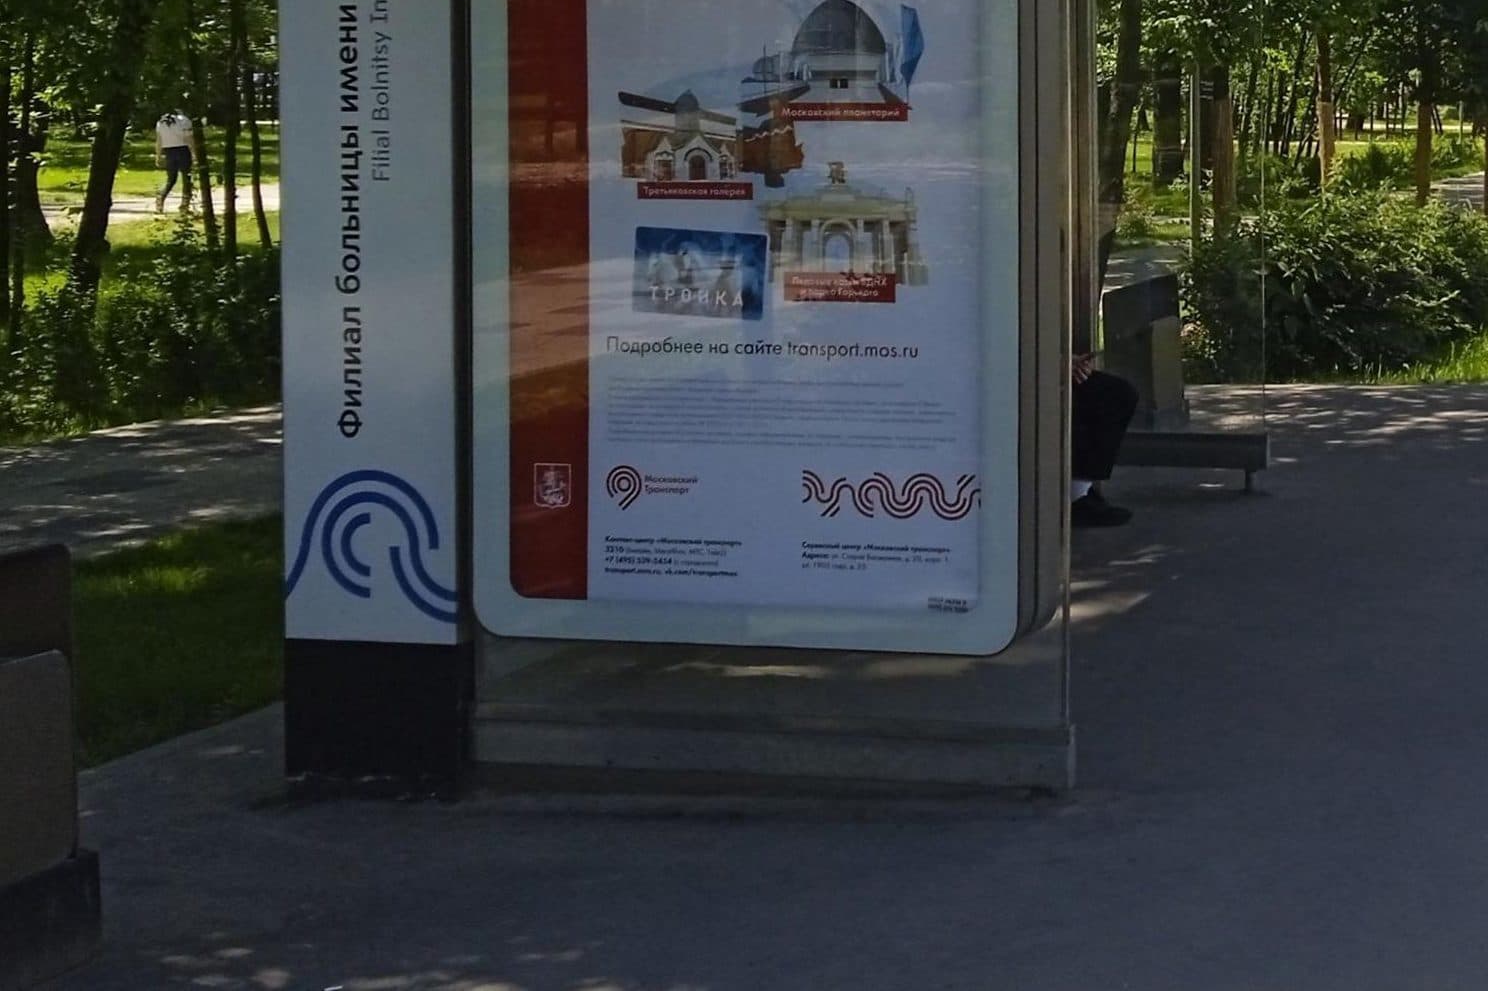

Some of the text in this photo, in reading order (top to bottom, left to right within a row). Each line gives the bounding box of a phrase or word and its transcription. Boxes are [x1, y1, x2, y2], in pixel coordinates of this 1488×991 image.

[339, 4, 359, 113] имени
[371, 31, 392, 122] Bolnitsy
[782, 107, 842, 118] Московский
[372, 129, 390, 182] Filial
[644, 186, 747, 196] Третьяковская галерея
[335, 125, 363, 295] больницы
[337, 306, 363, 439] Филиал
[605, 336, 919, 361] Подробнее на сайте transport.mos.ru
